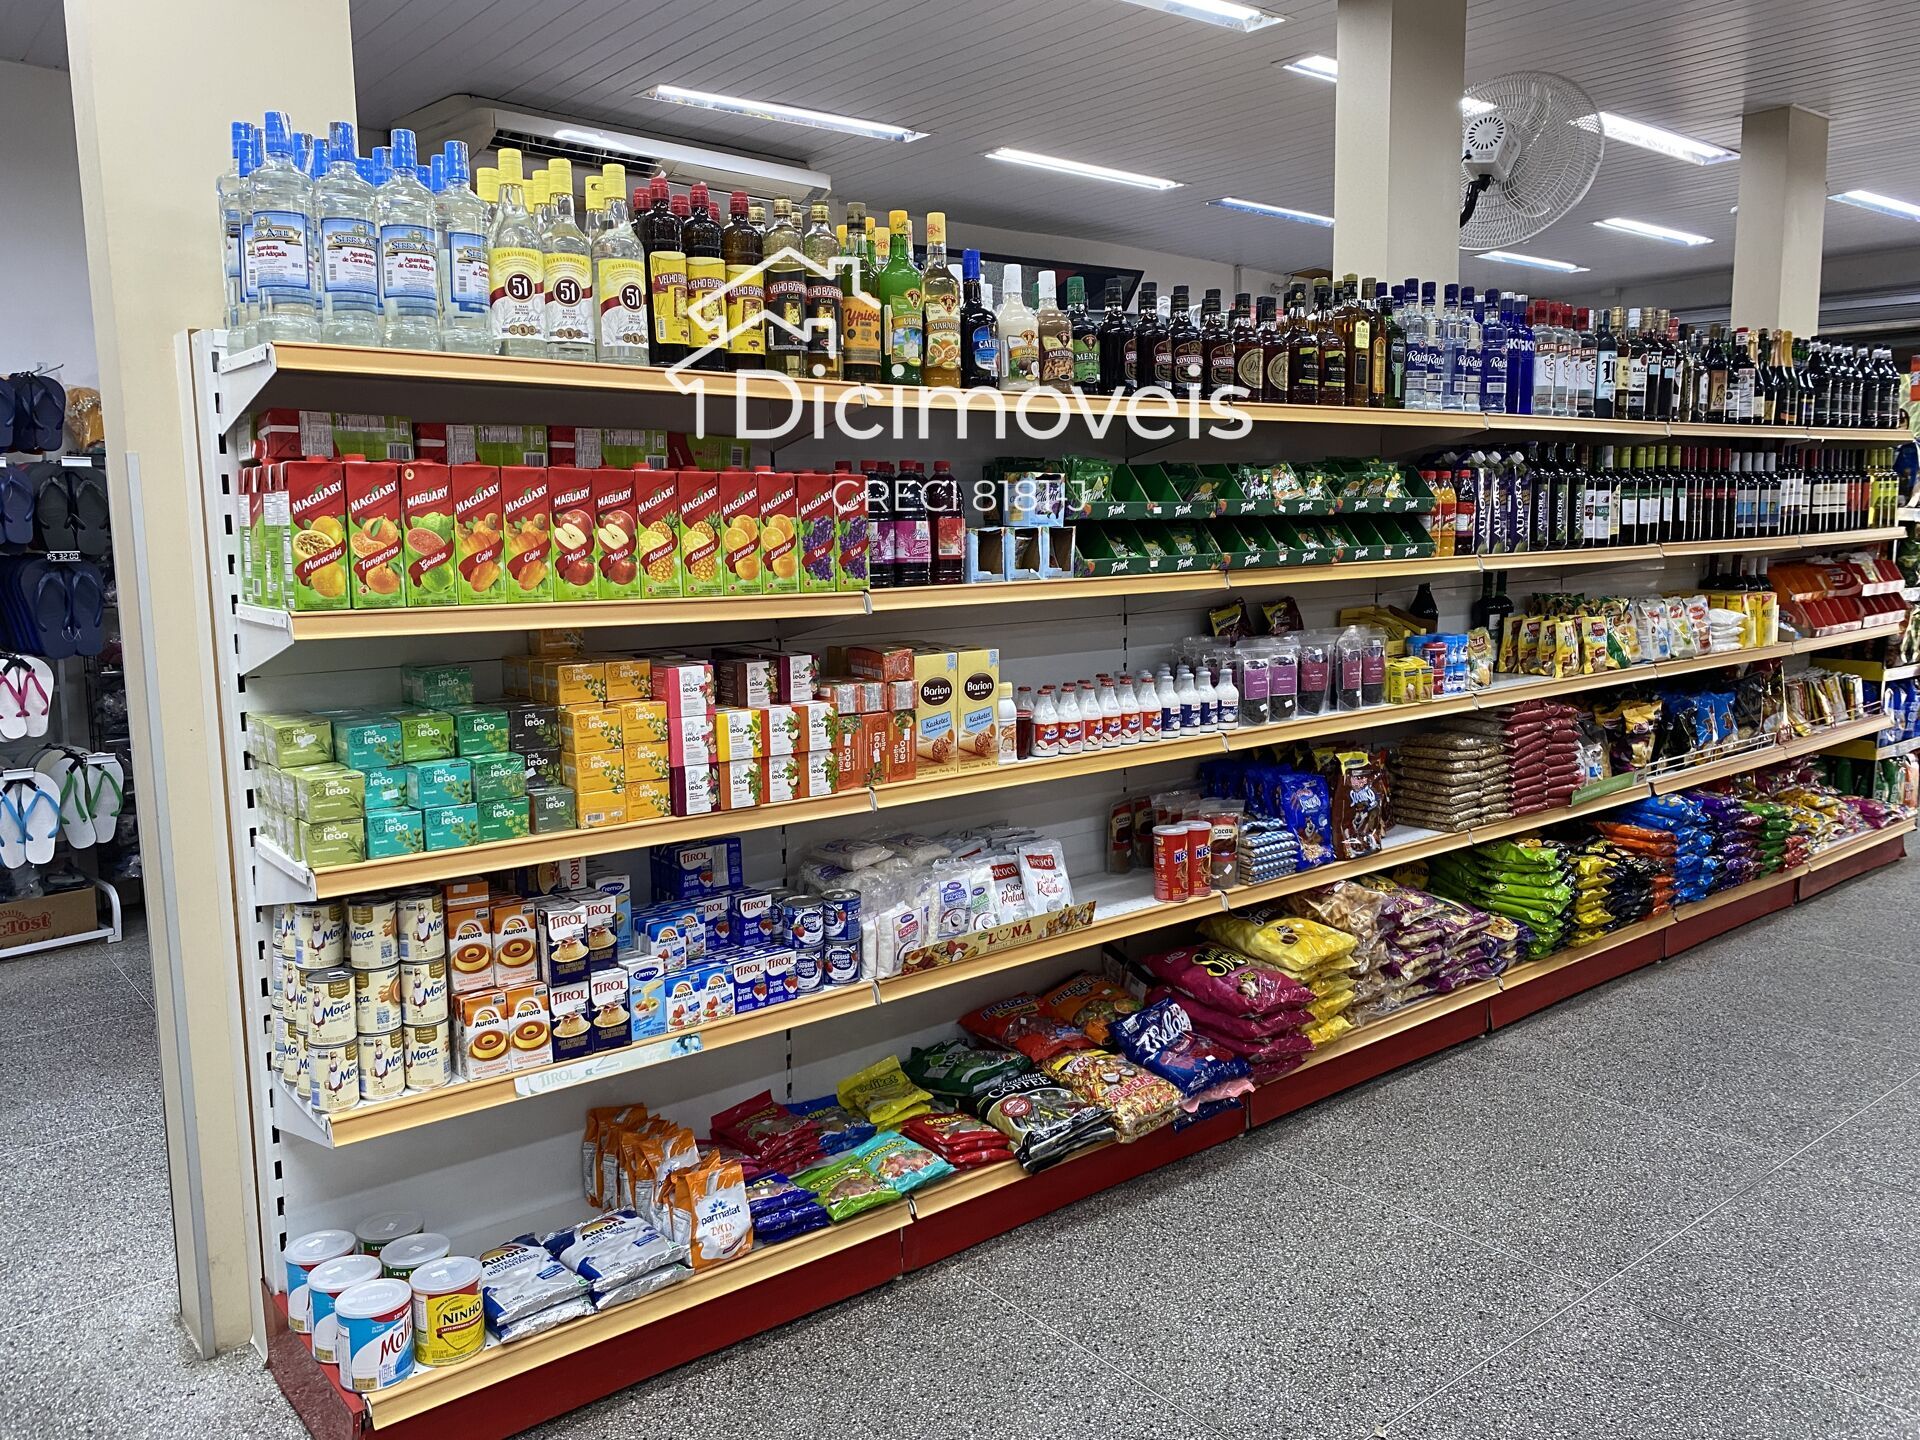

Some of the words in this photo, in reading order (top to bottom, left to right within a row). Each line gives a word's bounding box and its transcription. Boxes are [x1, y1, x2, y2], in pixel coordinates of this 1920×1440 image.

[658, 273, 678, 284] VELHO
[512, 278, 529, 296] 51
[560, 283, 575, 300] 51
[770, 283, 788, 294] VELHO
[626, 289, 640, 306] 51
[292, 480, 342, 514] MAGUARY
[351, 480, 397, 513] MAGUARY
[407, 486, 448, 508] MAGUARY
[456, 482, 499, 515] MAGUARY
[505, 484, 547, 514] MAGUARY
[554, 486, 590, 507] MAGUARY
[597, 488, 632, 508] MAGUARY
[638, 485, 675, 515] MAGUARY
[681, 487, 718, 516] MAGUARY
[722, 488, 758, 516] MAGUARY
[761, 488, 794, 515] MAGUARY
[800, 488, 833, 517] MAGUARY
[1108, 503, 1126, 517] Trink
[1175, 503, 1192, 517] Trink
[1241, 500, 1256, 514] Trink
[1299, 500, 1313, 513] Trink
[1355, 499, 1368, 511] Trink
[1405, 499, 1418, 511] Trink
[1516, 478, 1524, 536] AURORA
[359, 545, 398, 571] Tangerina
[476, 548, 493, 564] Caju
[524, 548, 541, 563] Caju
[565, 548, 586, 564] Maçã
[607, 548, 628, 564] Maçã
[648, 542, 673, 562] Abacaxi
[691, 543, 715, 562] Abacaxi
[732, 544, 755, 562] Laranja
[770, 542, 792, 561] Laranja
[814, 546, 826, 559] Uva
[850, 546, 862, 557] Uva
[1245, 552, 1261, 566] Trink
[1302, 550, 1317, 563] Trink
[1355, 546, 1368, 560] Trink
[1405, 546, 1418, 557] Trink
[304, 547, 342, 573] Maracujá
[420, 552, 447, 571] Goiaba
[1111, 559, 1130, 574] Trink
[1177, 557, 1194, 571] Trink
[924, 686, 950, 696] Barion
[967, 682, 992, 691] Barion
[682, 852, 710, 864] TIROL
[742, 900, 768, 910] TIROL
[503, 926, 528, 936] Aurora
[550, 915, 585, 931] TIROL
[457, 931, 482, 941] Aurora
[658, 935, 679, 945] Aurora
[736, 964, 763, 976] TIROL
[767, 957, 793, 969] TIROL
[592, 981, 626, 996] TIROL
[707, 981, 727, 991] Aurora
[552, 990, 587, 1006] TIROL
[673, 990, 693, 999] Aurora
[322, 1002, 352, 1019] Moça
[516, 1008, 541, 1019] Aurora
[474, 1017, 500, 1028] Aurora
[410, 1047, 438, 1063] Moça
[988, 1076, 1051, 1098] COFFEE
[863, 1140, 906, 1164] Gomets
[702, 1204, 740, 1227] parmalat
[582, 1220, 626, 1241] Aurora
[482, 1246, 529, 1268] Aurora
[491, 1254, 528, 1270] INTEGRAL
[443, 1300, 481, 1325] NINHO
